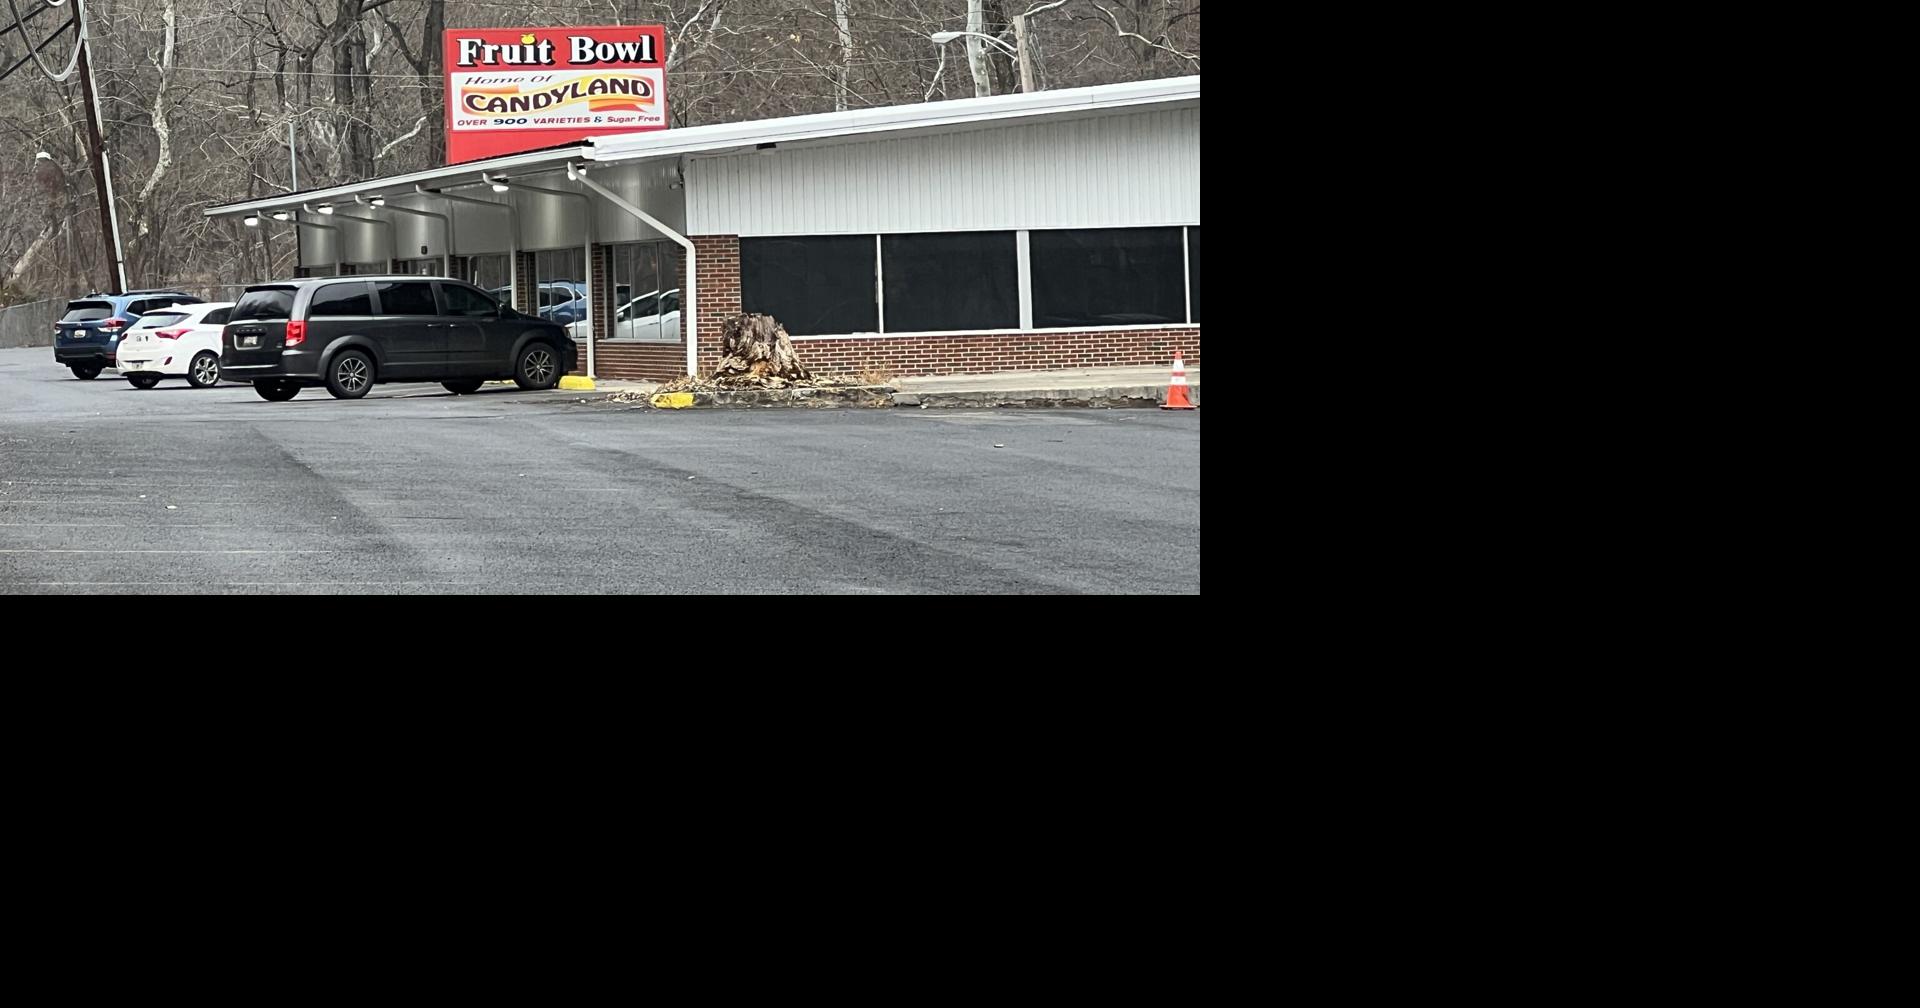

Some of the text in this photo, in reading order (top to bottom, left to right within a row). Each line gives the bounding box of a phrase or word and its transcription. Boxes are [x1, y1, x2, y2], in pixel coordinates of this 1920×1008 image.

[456, 33, 658, 67] Fruit Bowl
[465, 75, 553, 85] Home Of
[465, 78, 651, 113] CANDYLAND
[457, 118, 487, 126] OVER
[533, 116, 591, 124] VARIETIES
[594, 115, 602, 123] &
[607, 115, 635, 125] Sugar
